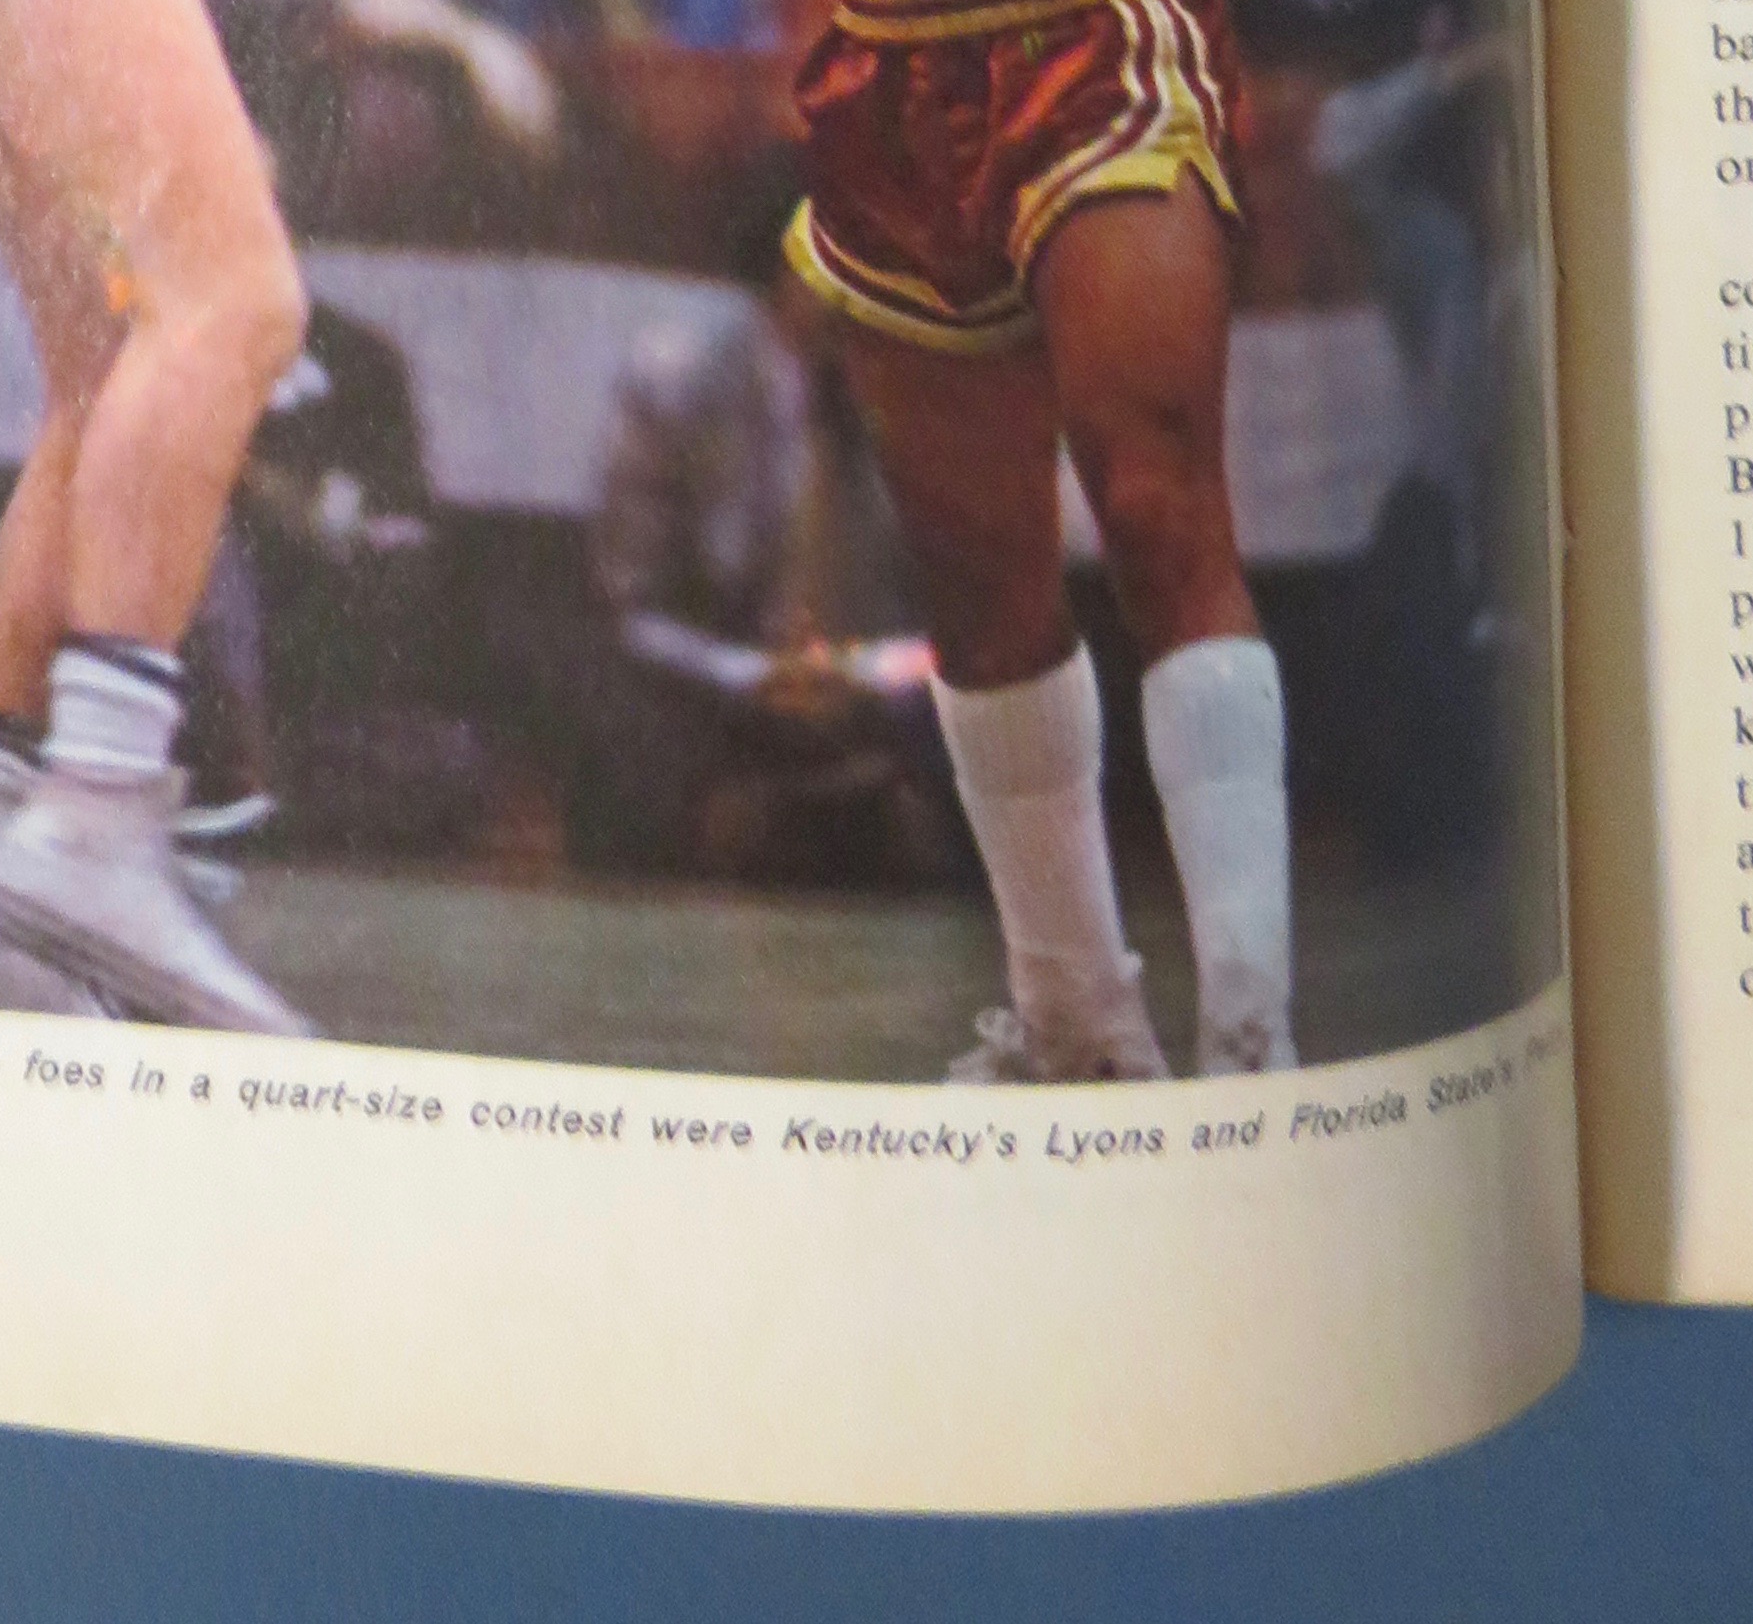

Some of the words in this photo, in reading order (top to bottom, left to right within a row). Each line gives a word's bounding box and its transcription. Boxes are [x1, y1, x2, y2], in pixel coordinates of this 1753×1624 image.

[25, 1051, 104, 1087] foes
[132, 1069, 165, 1093] in
[191, 1075, 210, 1100] a
[239, 1080, 443, 1121] quart-size
[471, 1102, 624, 1139] contest
[652, 1118, 752, 1147] were
[1045, 1123, 1165, 1164] Lyons
[1192, 1111, 1264, 1151] and
[1290, 1090, 1407, 1140] Florida
